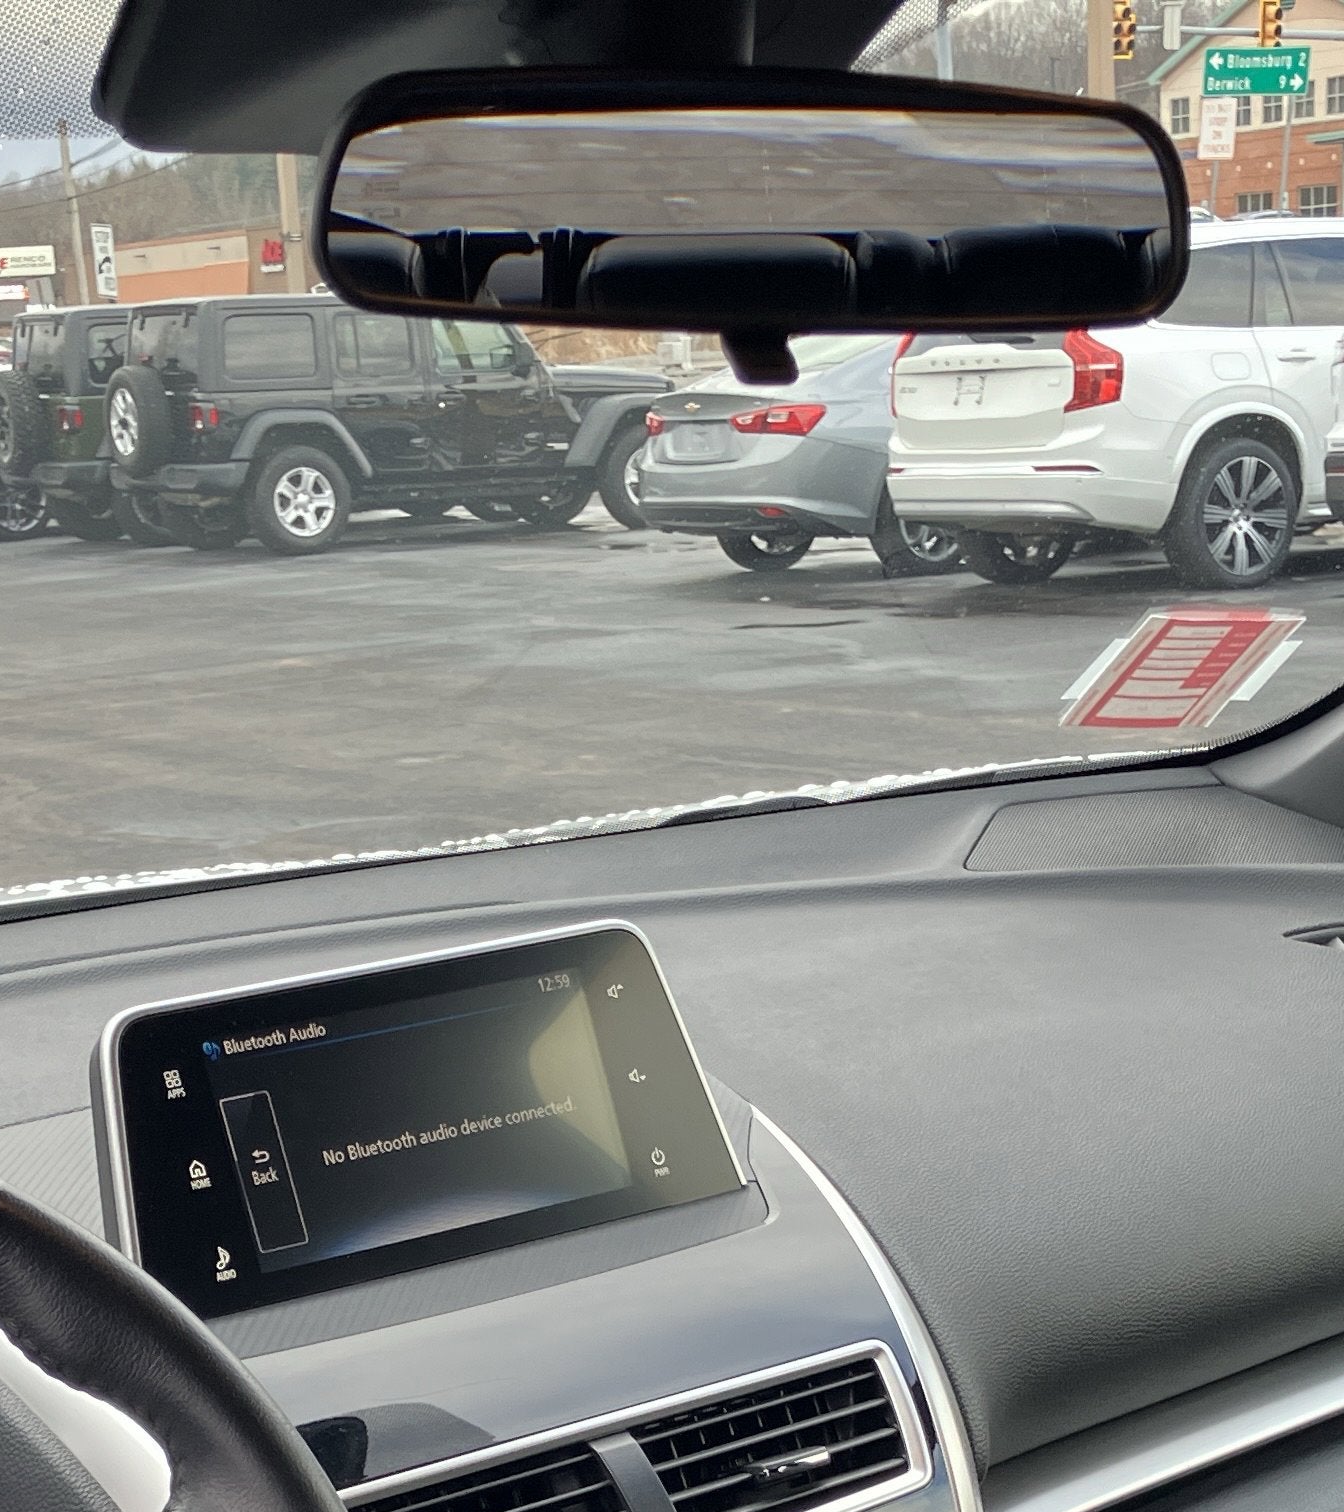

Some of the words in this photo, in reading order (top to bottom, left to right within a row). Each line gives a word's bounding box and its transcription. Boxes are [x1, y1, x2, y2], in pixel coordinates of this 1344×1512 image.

[1227, 54, 1293, 70] Bloomsburg
[1298, 52, 1307, 67] 2
[1279, 75, 1287, 89] 9
[537, 974, 571, 993] 12:59
[222, 1029, 287, 1055] Bluetooth
[289, 1022, 327, 1045] Audio
[167, 1087, 186, 1099] APPS
[322, 1148, 345, 1166] No
[347, 1131, 417, 1162] Bluetooth
[419, 1125, 458, 1145] audio
[460, 1114, 503, 1136] device
[505, 1096, 576, 1126] connected.
[190, 1177, 212, 1190] HOME
[251, 1167, 279, 1186] Back
[216, 1269, 237, 1282] AUDIO
